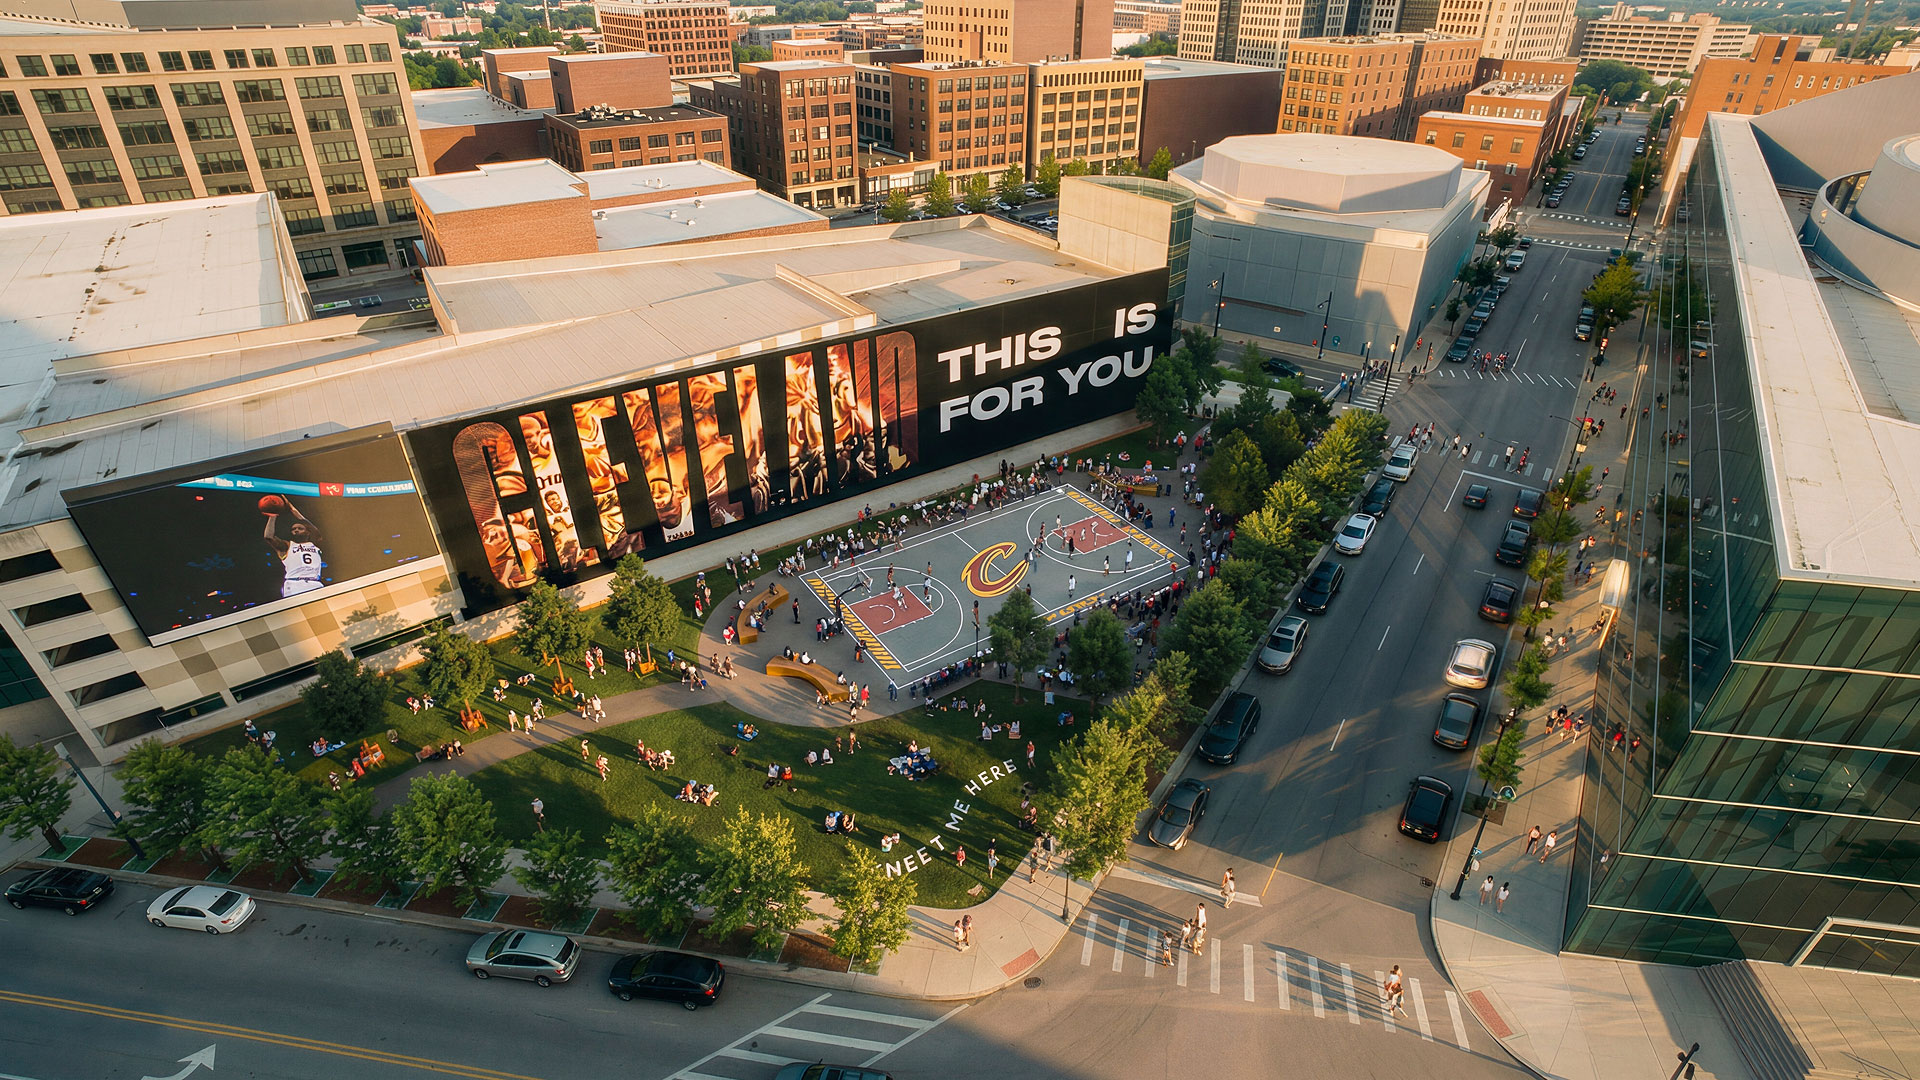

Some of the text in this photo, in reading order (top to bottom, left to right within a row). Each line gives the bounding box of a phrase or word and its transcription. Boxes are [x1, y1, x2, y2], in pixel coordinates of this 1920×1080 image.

[937, 302, 1157, 383] THIS IS
[940, 345, 1153, 433] FOR YOU
[303, 553, 312, 565] 6
[945, 799, 970, 832] ME
[964, 759, 1017, 796] HERE
